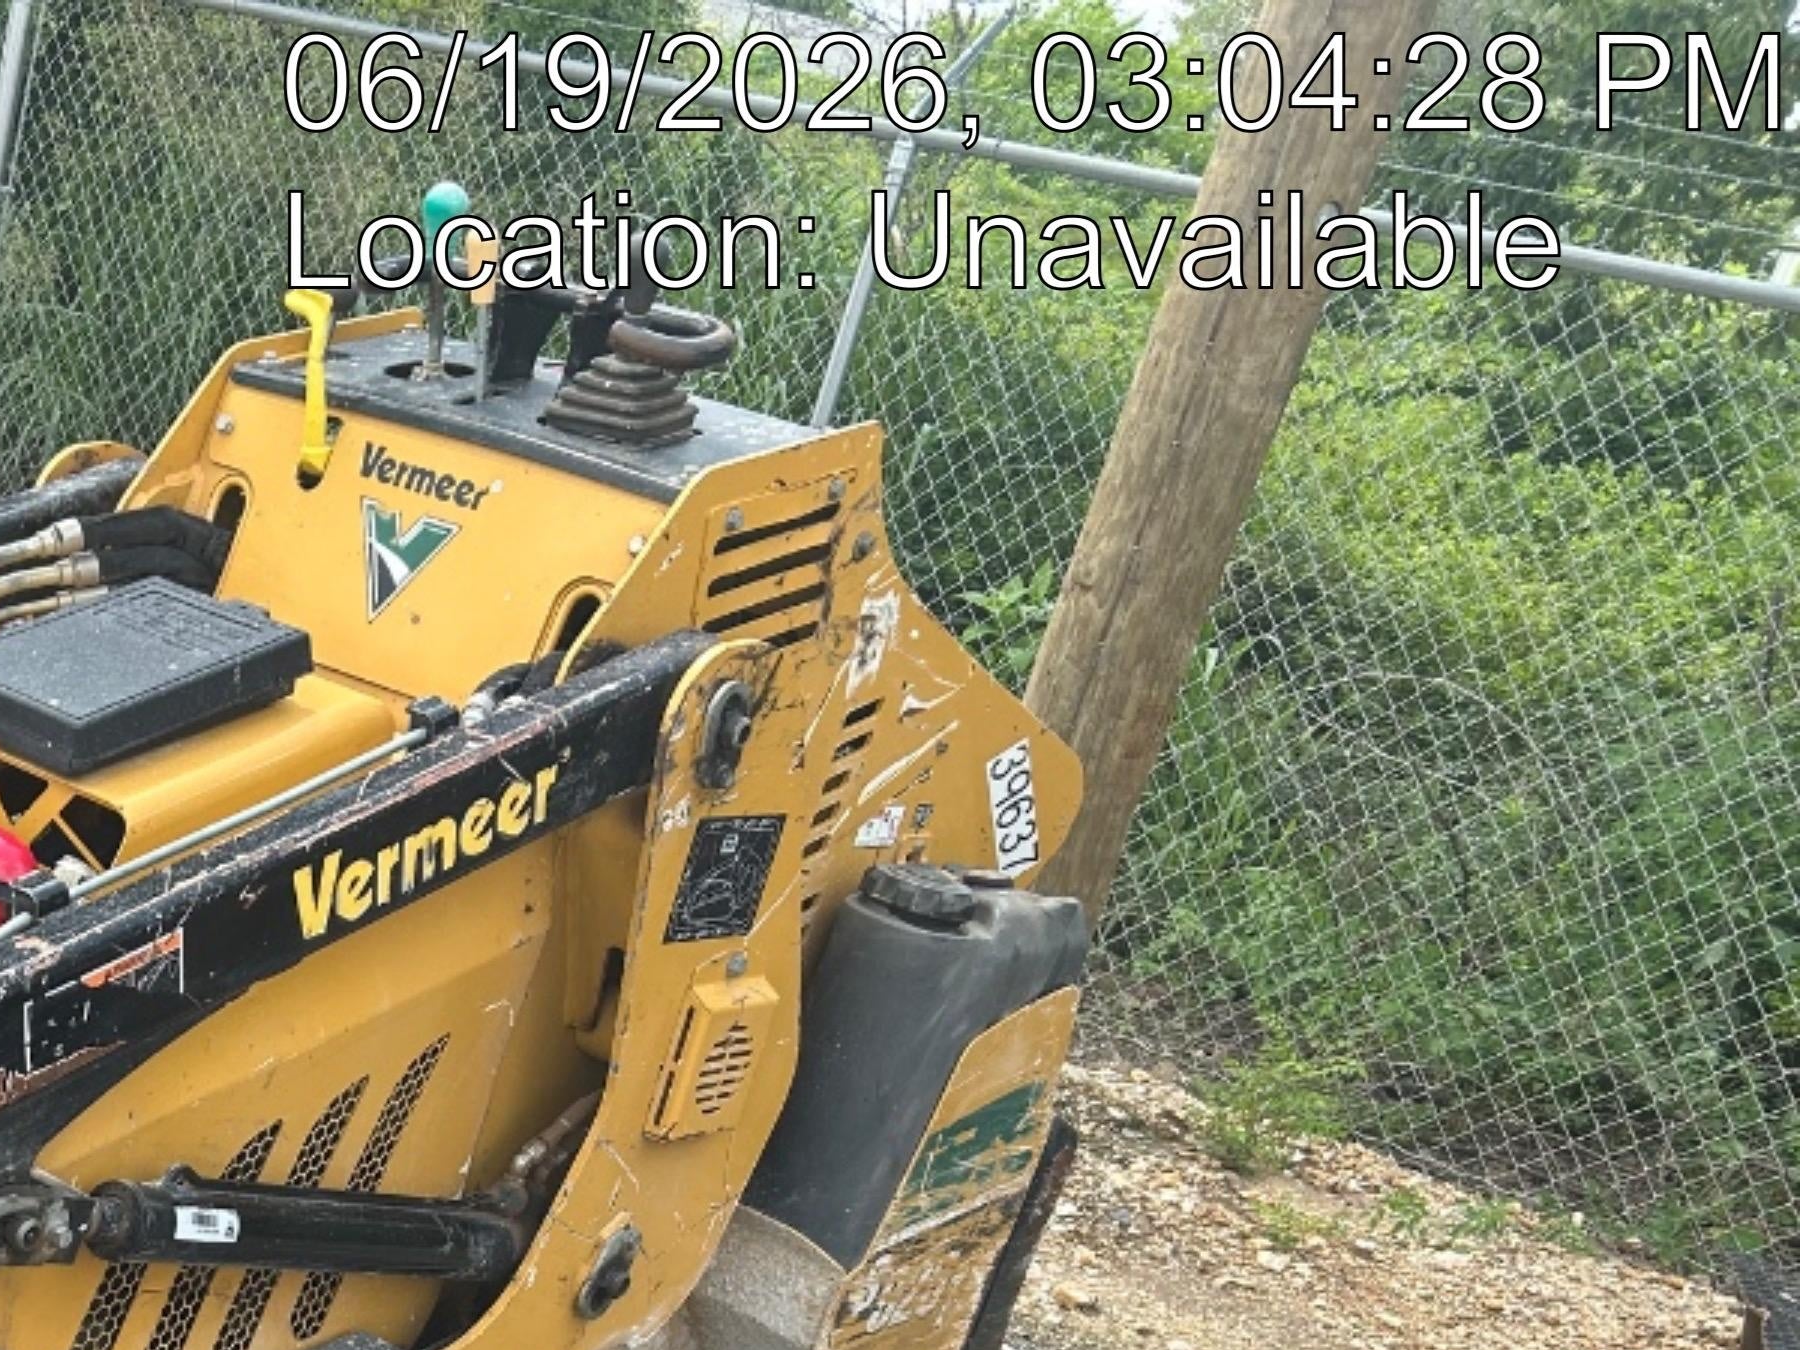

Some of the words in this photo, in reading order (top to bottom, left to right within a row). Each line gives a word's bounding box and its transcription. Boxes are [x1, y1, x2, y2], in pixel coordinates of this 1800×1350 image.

[360, 441, 489, 510] Vermeer
[293, 763, 559, 939] Vermeer
[988, 742, 1040, 872] 39637
